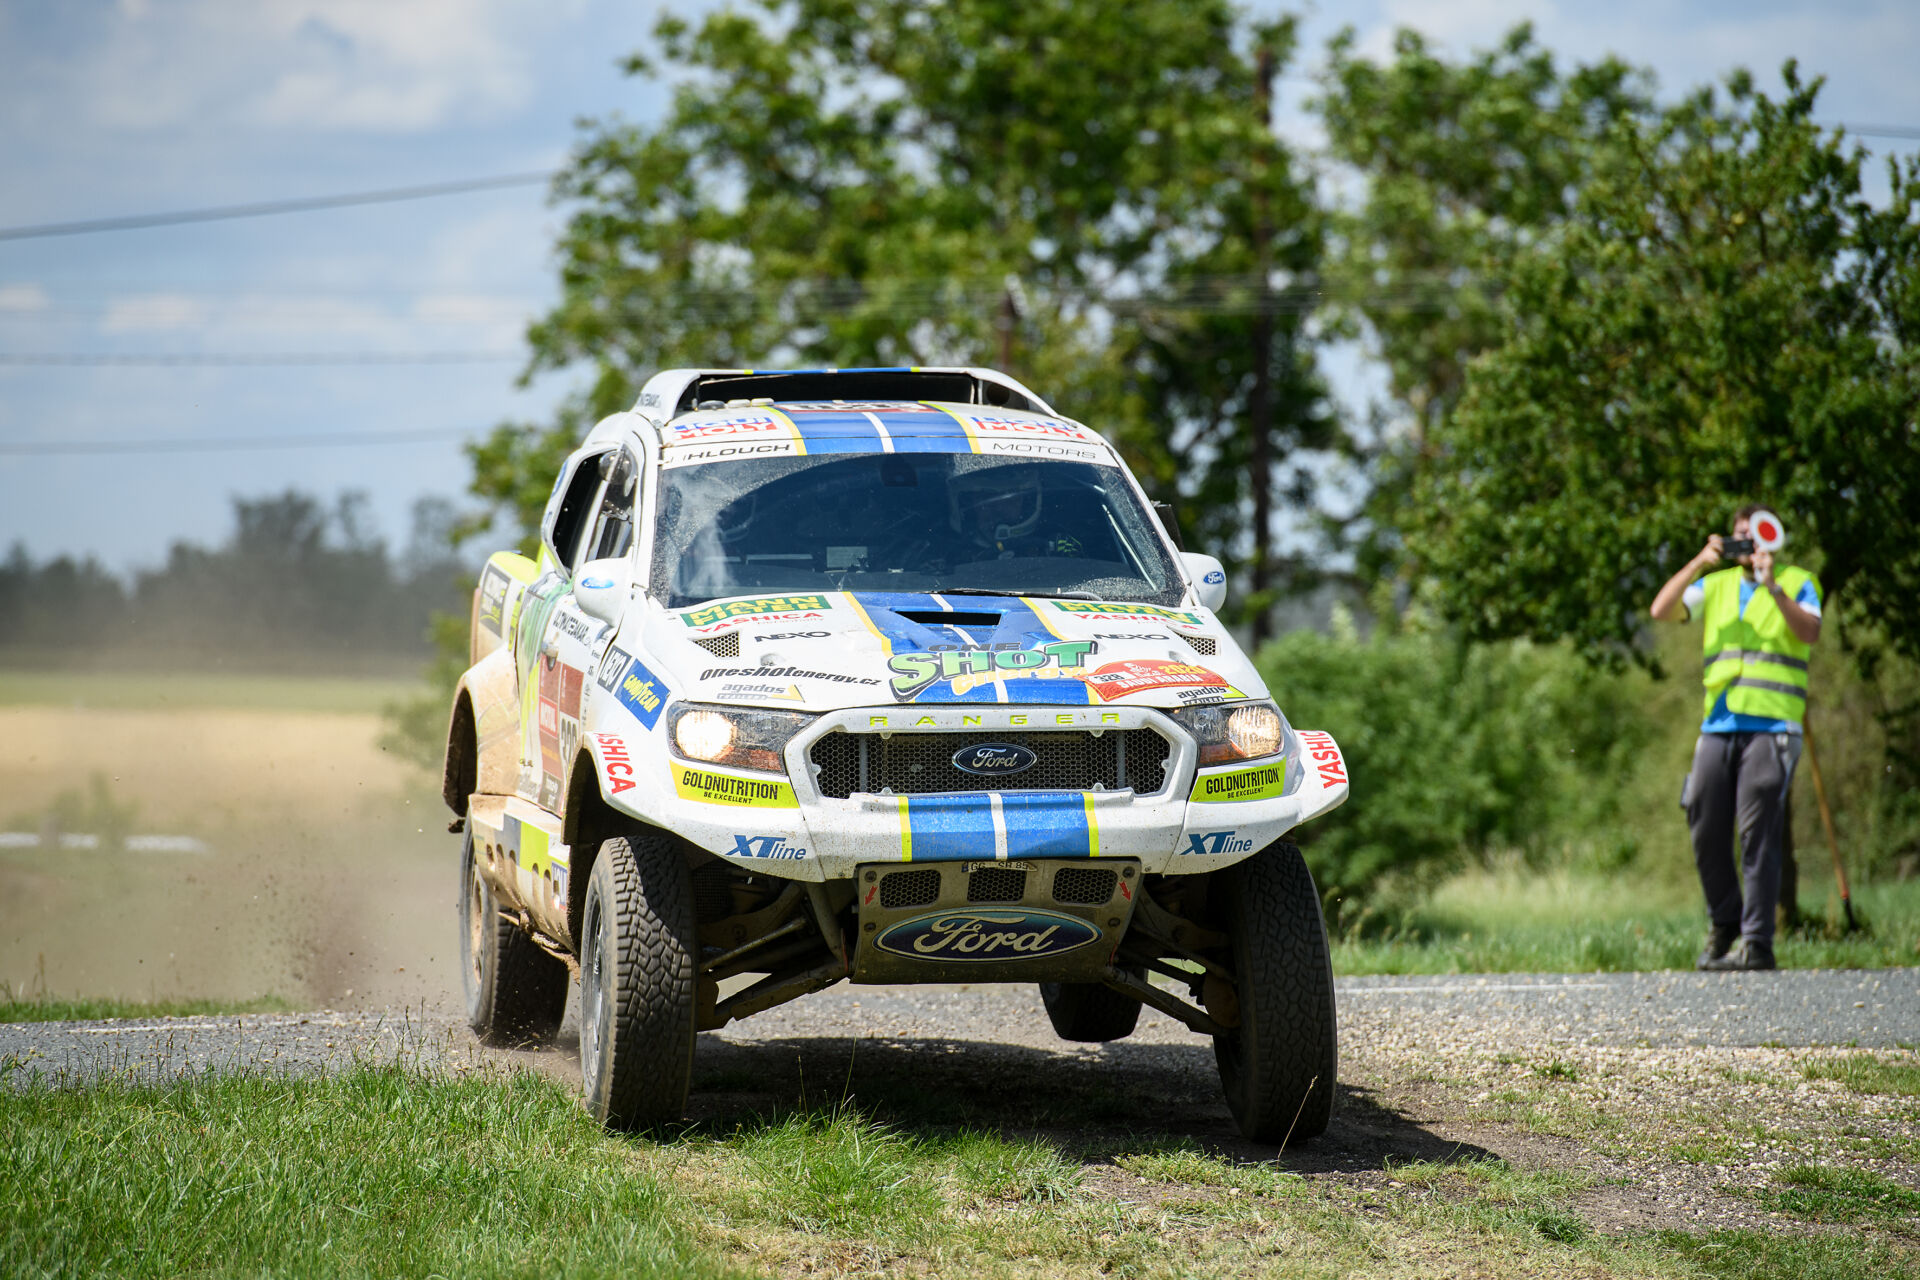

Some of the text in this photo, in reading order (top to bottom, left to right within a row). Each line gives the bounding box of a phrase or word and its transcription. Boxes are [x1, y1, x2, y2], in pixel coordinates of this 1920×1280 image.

[674, 424, 777, 441] MOLY
[976, 421, 1085, 439] MOLY
[687, 442, 1096, 461] HLOUCH MOTORS
[689, 596, 819, 618] MANN
[694, 602, 825, 626] FILTER
[695, 612, 824, 633] YASHICA
[754, 631, 831, 643] NEXO
[928, 641, 1021, 652] ONE
[1094, 633, 1170, 641] NEXO
[700, 666, 882, 686] oneshotenergy.cz
[887, 640, 1099, 703] SHOT
[1158, 664, 1208, 675] 2020
[721, 683, 786, 695] agados
[1116, 674, 1204, 688] SAUDI ARABIA
[1176, 686, 1227, 699] agados
[869, 713, 1121, 727] RANGER
[972, 747, 1018, 769] Ford
[1297, 730, 1348, 789] YASHIC
[682, 770, 779, 800] GOLDNUTRITION
[1206, 769, 1280, 795] GOLDNUTRITION
[703, 791, 753, 805] BE EXCELLENT
[1227, 786, 1264, 799] BE EXCELLENT
[725, 834, 807, 860] XTline
[1180, 831, 1253, 856] XTline
[914, 914, 1061, 953] Ford
